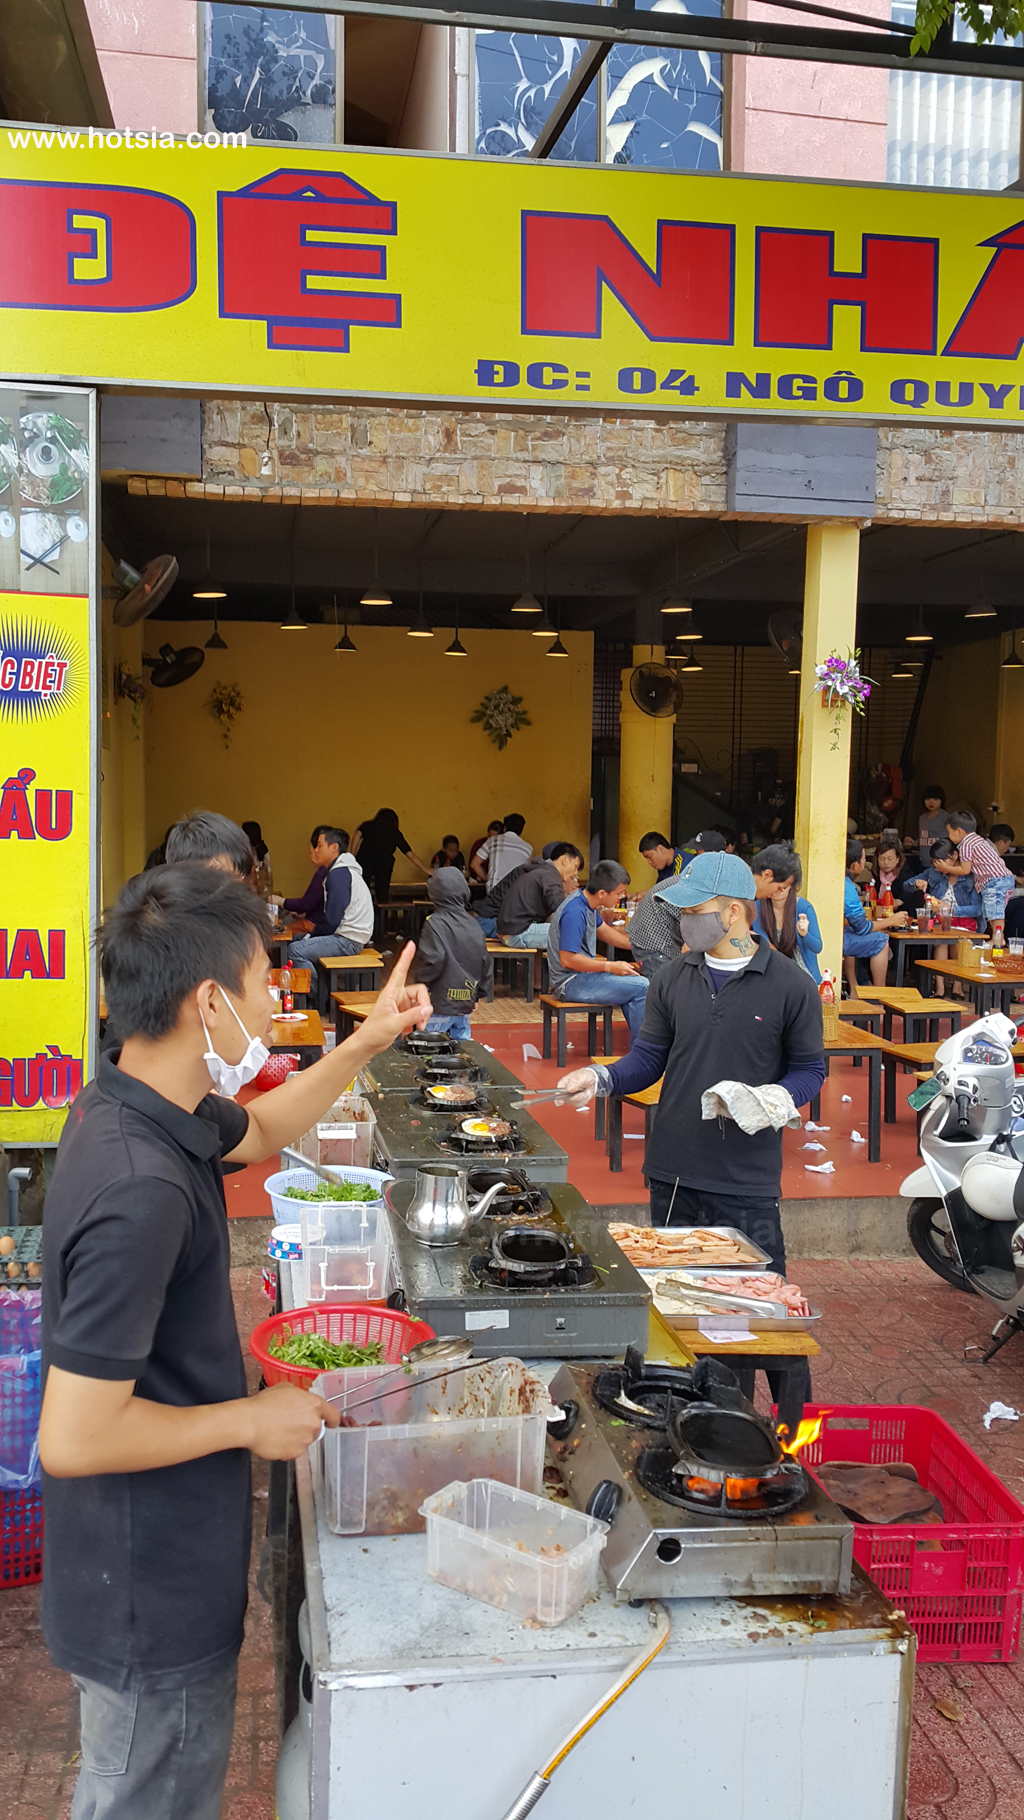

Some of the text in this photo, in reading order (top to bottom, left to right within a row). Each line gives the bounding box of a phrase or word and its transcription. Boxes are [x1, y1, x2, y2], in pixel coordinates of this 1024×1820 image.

[474, 359, 1024, 410] ĐC: 04 NGÔ QUY
[18, 653, 69, 700] BIỆT
[0, 929, 65, 979] AI
